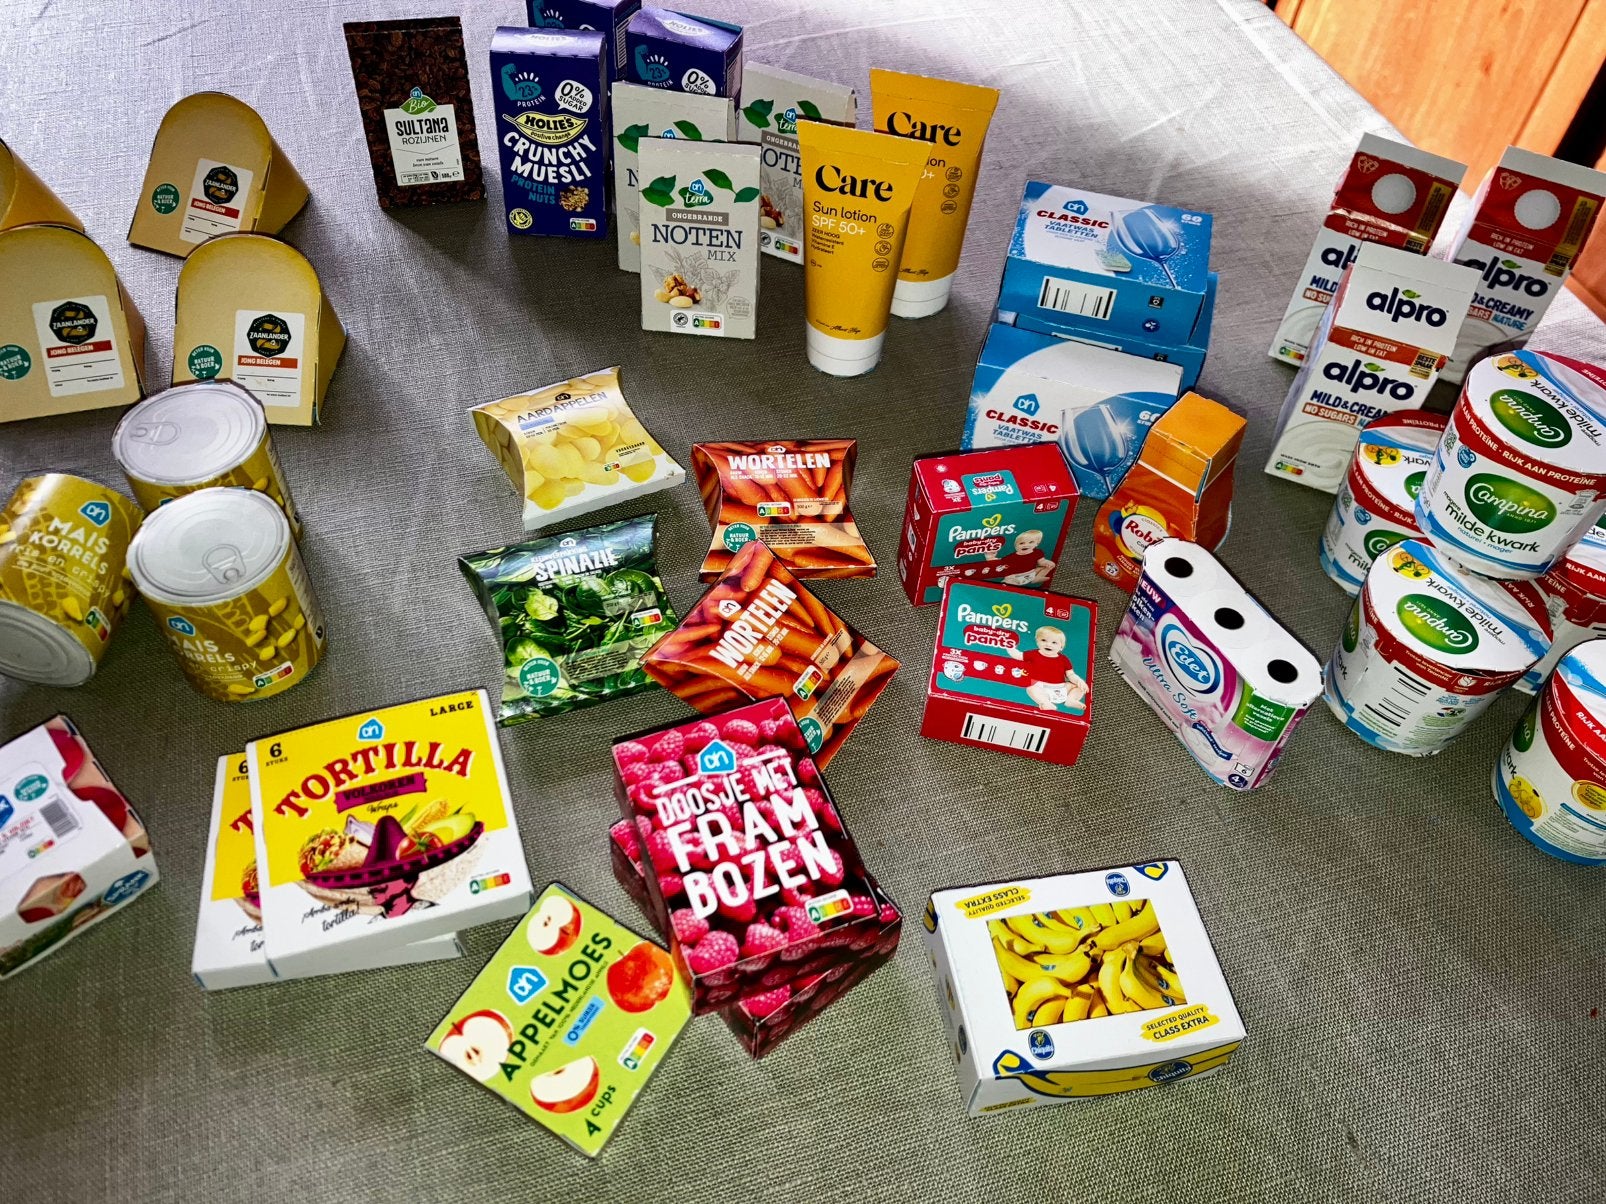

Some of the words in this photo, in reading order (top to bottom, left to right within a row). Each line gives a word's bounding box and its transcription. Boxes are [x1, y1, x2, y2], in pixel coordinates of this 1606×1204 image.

[561, 82, 584, 98] 0%
[408, 100, 429, 112] Bio
[518, 95, 546, 107] PROTEIN
[558, 96, 584, 111] SUGAR
[569, 95, 587, 107] ADDED
[524, 116, 574, 130] HOLIE'S
[887, 111, 961, 146] Care
[402, 134, 447, 145] ROZIJNEN
[504, 132, 596, 165] CRUNCHY
[510, 156, 591, 183] MUESLI
[511, 175, 555, 194] PROTEIN
[816, 165, 893, 202] Care
[528, 192, 555, 204] NUTS
[684, 192, 710, 204] terra
[672, 212, 724, 223] ONGEBRANDE
[813, 201, 837, 217] Sun
[841, 207, 876, 223] lotion
[1037, 210, 1109, 228] CLASSIC
[812, 215, 836, 230] SPF
[839, 222, 866, 235] 50+
[1044, 225, 1098, 238] TABLETTEN
[1049, 221, 1095, 233] VAATWAS
[651, 224, 743, 249] NOTEN
[707, 250, 737, 262] MIX
[1366, 287, 1447, 327] alpro
[52, 318, 95, 330] ZAANLANDER
[250, 332, 288, 341] ZAANLANDER
[1351, 334, 1364, 342] RICH
[1373, 340, 1398, 352] PROTEIN
[50, 348, 66, 356] JONG
[67, 345, 93, 353] BELEGEN
[1354, 344, 1367, 352] LOW
[1323, 359, 1414, 401] alpro
[1530, 379, 1568, 409] kwark
[517, 391, 608, 423] AARDAPPELEN
[1304, 404, 1317, 414] NO
[1318, 407, 1356, 424] SUGARS
[985, 409, 1059, 434] CLASSIC
[1500, 394, 1565, 442] Campina
[1566, 408, 1602, 437] milde
[998, 424, 1042, 439] VAATWAS
[728, 453, 830, 470] WORTELEN
[1502, 451, 1524, 467] RIJK
[1525, 463, 1547, 475] AAN
[1548, 470, 1597, 486] PROTEÏNE
[972, 484, 1013, 495] Pampers
[1470, 482, 1549, 520] Campina
[48, 517, 109, 554] MAIS
[949, 524, 1014, 542] Pampers
[1445, 504, 1485, 536] milde
[1486, 530, 1541, 553] kwark
[29, 531, 108, 575] KORRELS
[954, 542, 1002, 558] pants
[535, 548, 618, 582] SPINAZIE
[1566, 563, 1585, 575] RIJK
[1586, 571, 1606, 582] AAN
[1426, 578, 1466, 607] kwark
[709, 579, 797, 669] WORTELEN
[957, 604, 1027, 633] Pampers
[1404, 601, 1473, 647] Campina
[1465, 607, 1504, 636] milde
[965, 632, 1016, 649] pants
[974, 626, 1010, 637] baby-dry
[1170, 643, 1210, 682] Edet
[1143, 657, 1171, 693] Ultra
[1173, 692, 1197, 720] Soft
[430, 701, 474, 716] LARGE
[1576, 711, 1595, 730] RIJK
[270, 743, 283, 758] 6
[273, 741, 475, 819] TORTILLA
[342, 776, 415, 799] VOLKOREN
[656, 772, 749, 827] DOOSJE
[752, 757, 797, 797] MET
[367, 802, 399, 814] Wraps
[666, 787, 820, 873] FRAM
[682, 830, 839, 920] BOZEN
[964, 895, 992, 909] EXTRA
[994, 887, 1019, 902] CLASS
[994, 895, 1026, 909] SELECTED
[968, 904, 995, 917] QUALITY
[499, 932, 612, 1082] APPELMOES
[1146, 1015, 1177, 1030] SELECTED
[1178, 1007, 1205, 1021] QUALITY
[1154, 1025, 1180, 1040] CLASS
[1181, 1015, 1210, 1031] EXTRA
[591, 1084, 616, 1118] cups
[585, 1119, 602, 1137] 4
